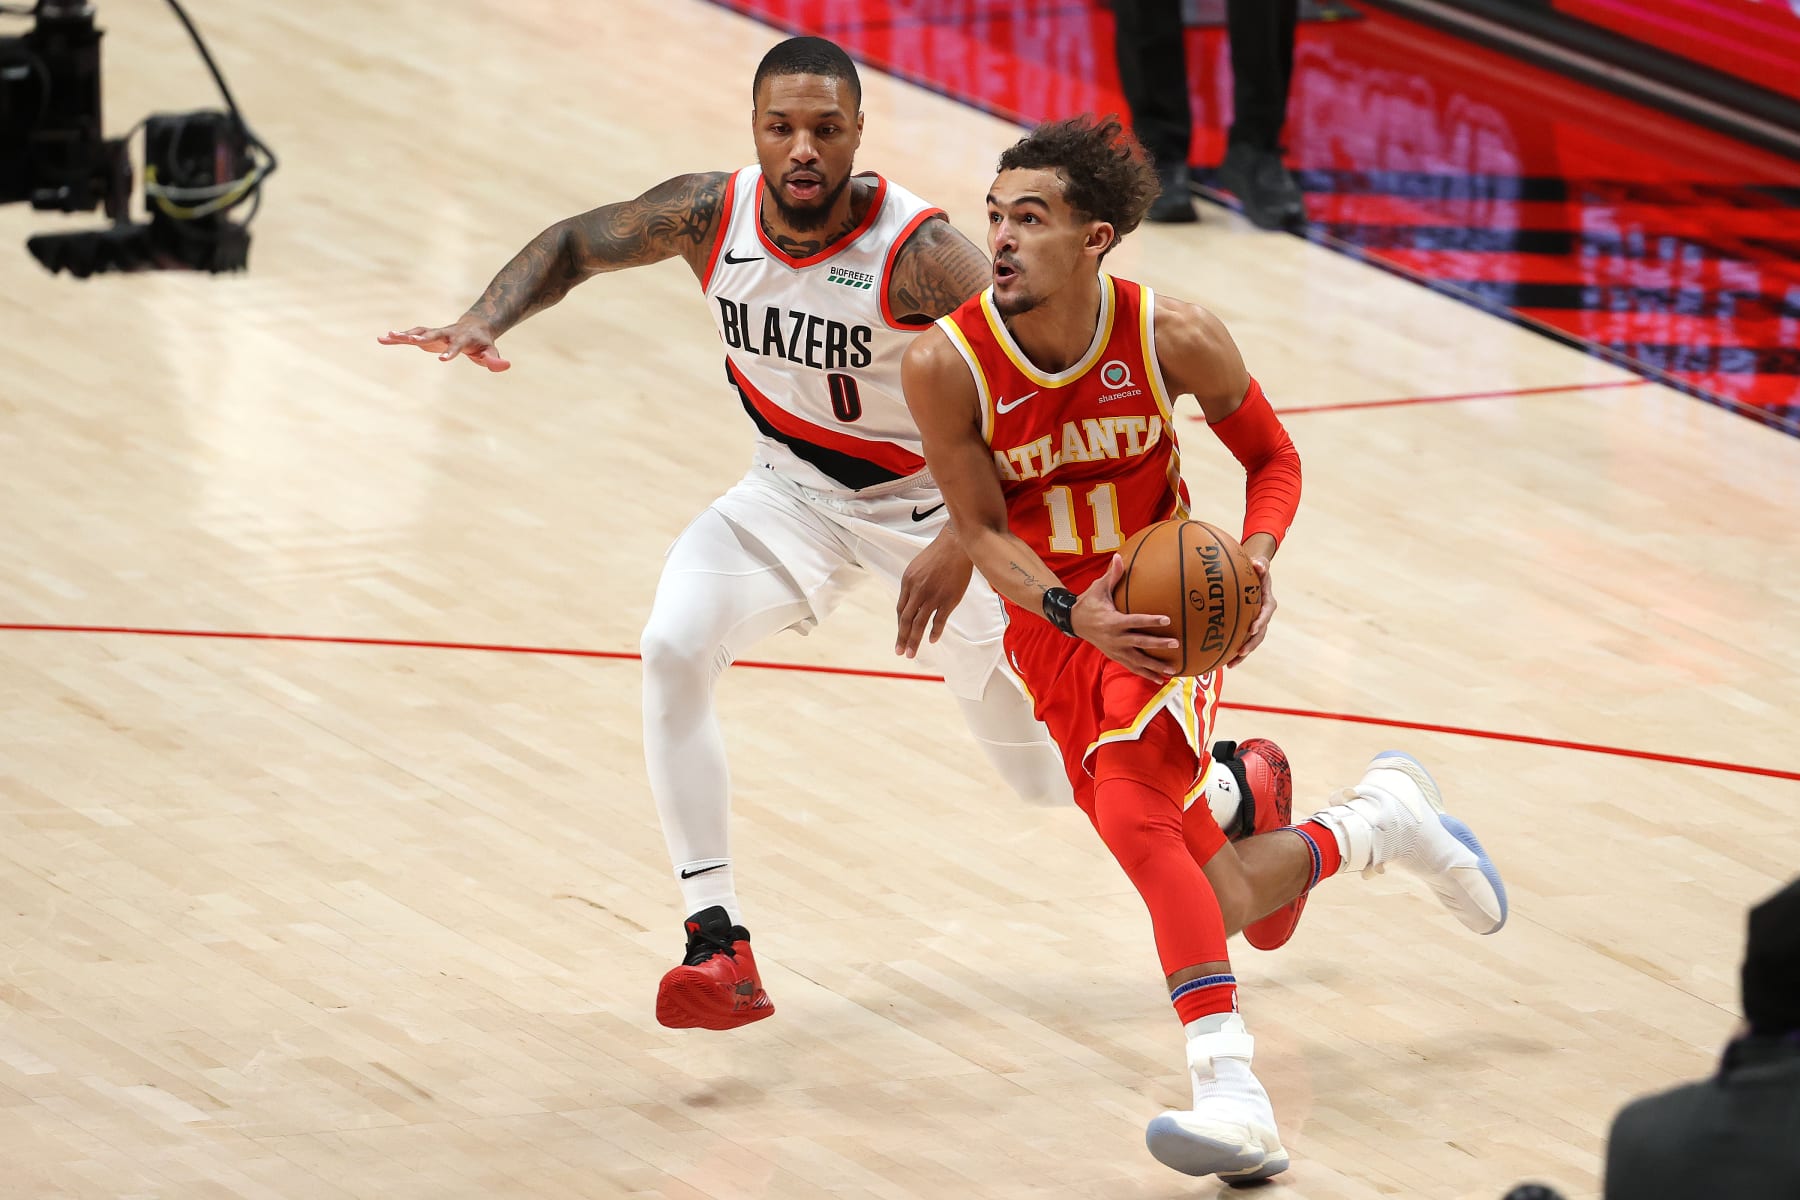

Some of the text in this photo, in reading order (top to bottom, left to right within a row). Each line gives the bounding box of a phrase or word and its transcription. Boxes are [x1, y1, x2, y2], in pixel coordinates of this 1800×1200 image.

[830, 266, 875, 283] BIOFREEZE
[715, 296, 872, 370] BLAZERS
[827, 373, 863, 423] 0
[1098, 388, 1142, 404] sharecare
[993, 414, 1163, 482] ATLANTA
[1042, 482, 1126, 556] 11
[1195, 545, 1225, 653] SPALDING
